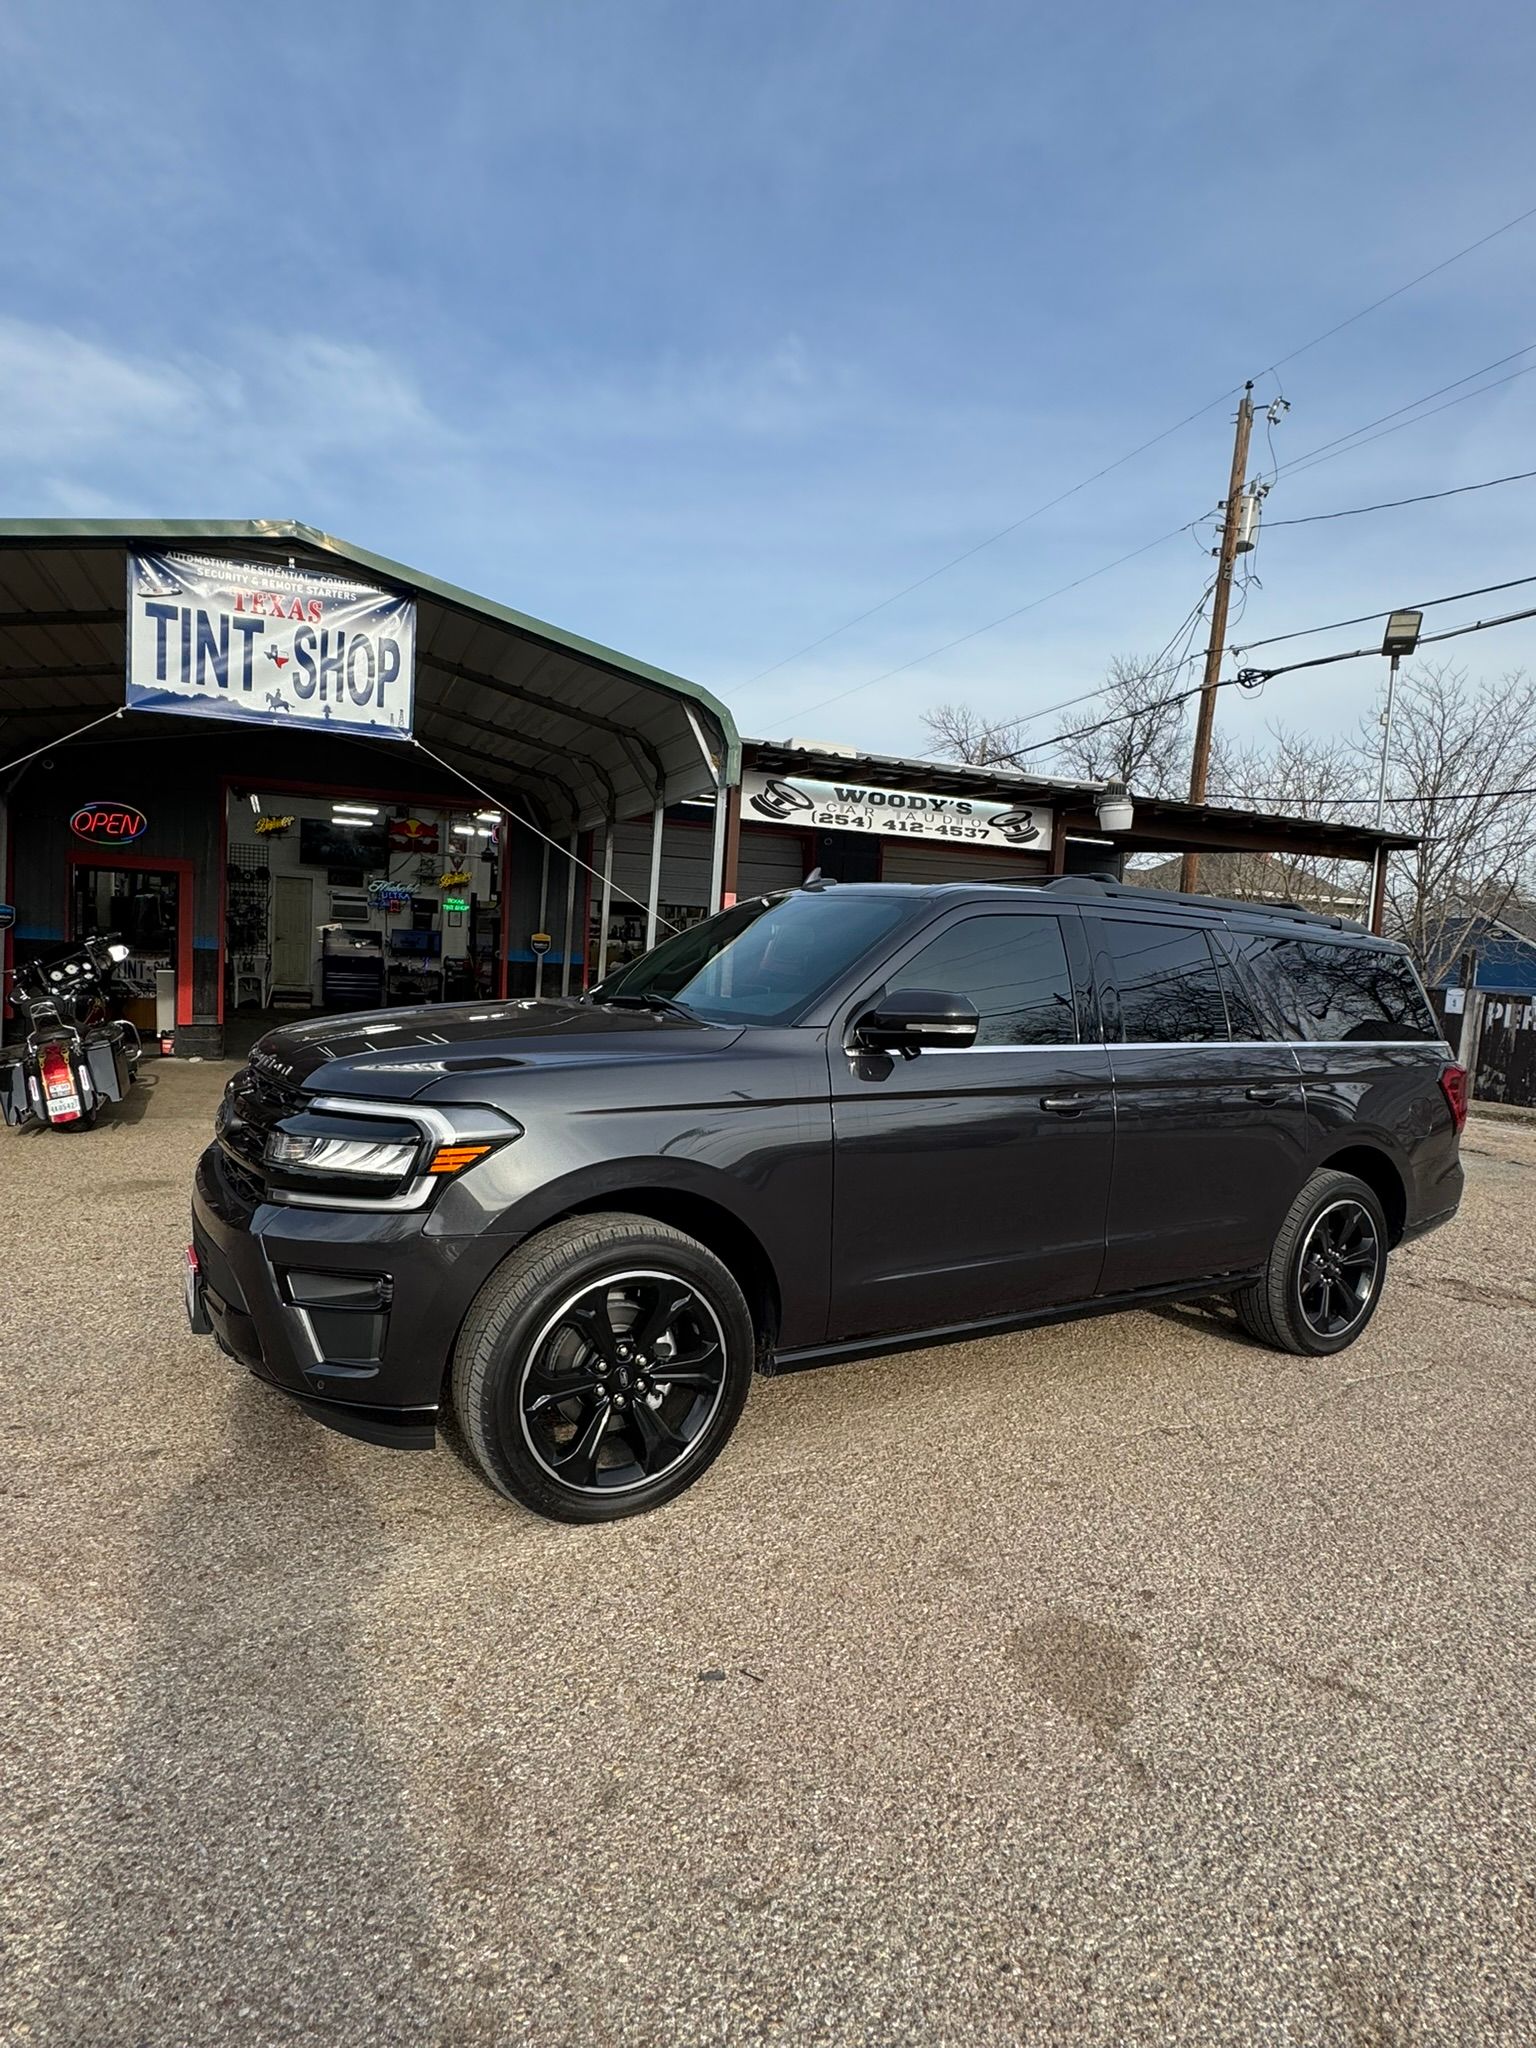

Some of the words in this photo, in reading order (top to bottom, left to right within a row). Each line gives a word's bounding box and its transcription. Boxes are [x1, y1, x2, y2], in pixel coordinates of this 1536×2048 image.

[165, 551, 234, 571] AUTOMOTIVE
[243, 563, 311, 583] RESIDENTIAL
[319, 576, 385, 595] COMMERCIAL
[197, 567, 249, 584] SECURITY
[251, 577, 259, 586] &
[261, 578, 303, 593] REMOTE
[306, 586, 357, 602] STARTERS
[233, 589, 324, 625] TEXAS
[145, 601, 265, 692] TINT
[292, 624, 401, 708] SHOP
[825, 802, 876, 817] CAR
[906, 811, 982, 828] AUDIO
[833, 786, 973, 816] WOODY'S
[73, 811, 140, 836] OPEN
[811, 809, 874, 830] (254)
[881, 819, 990, 840] 412-4537
